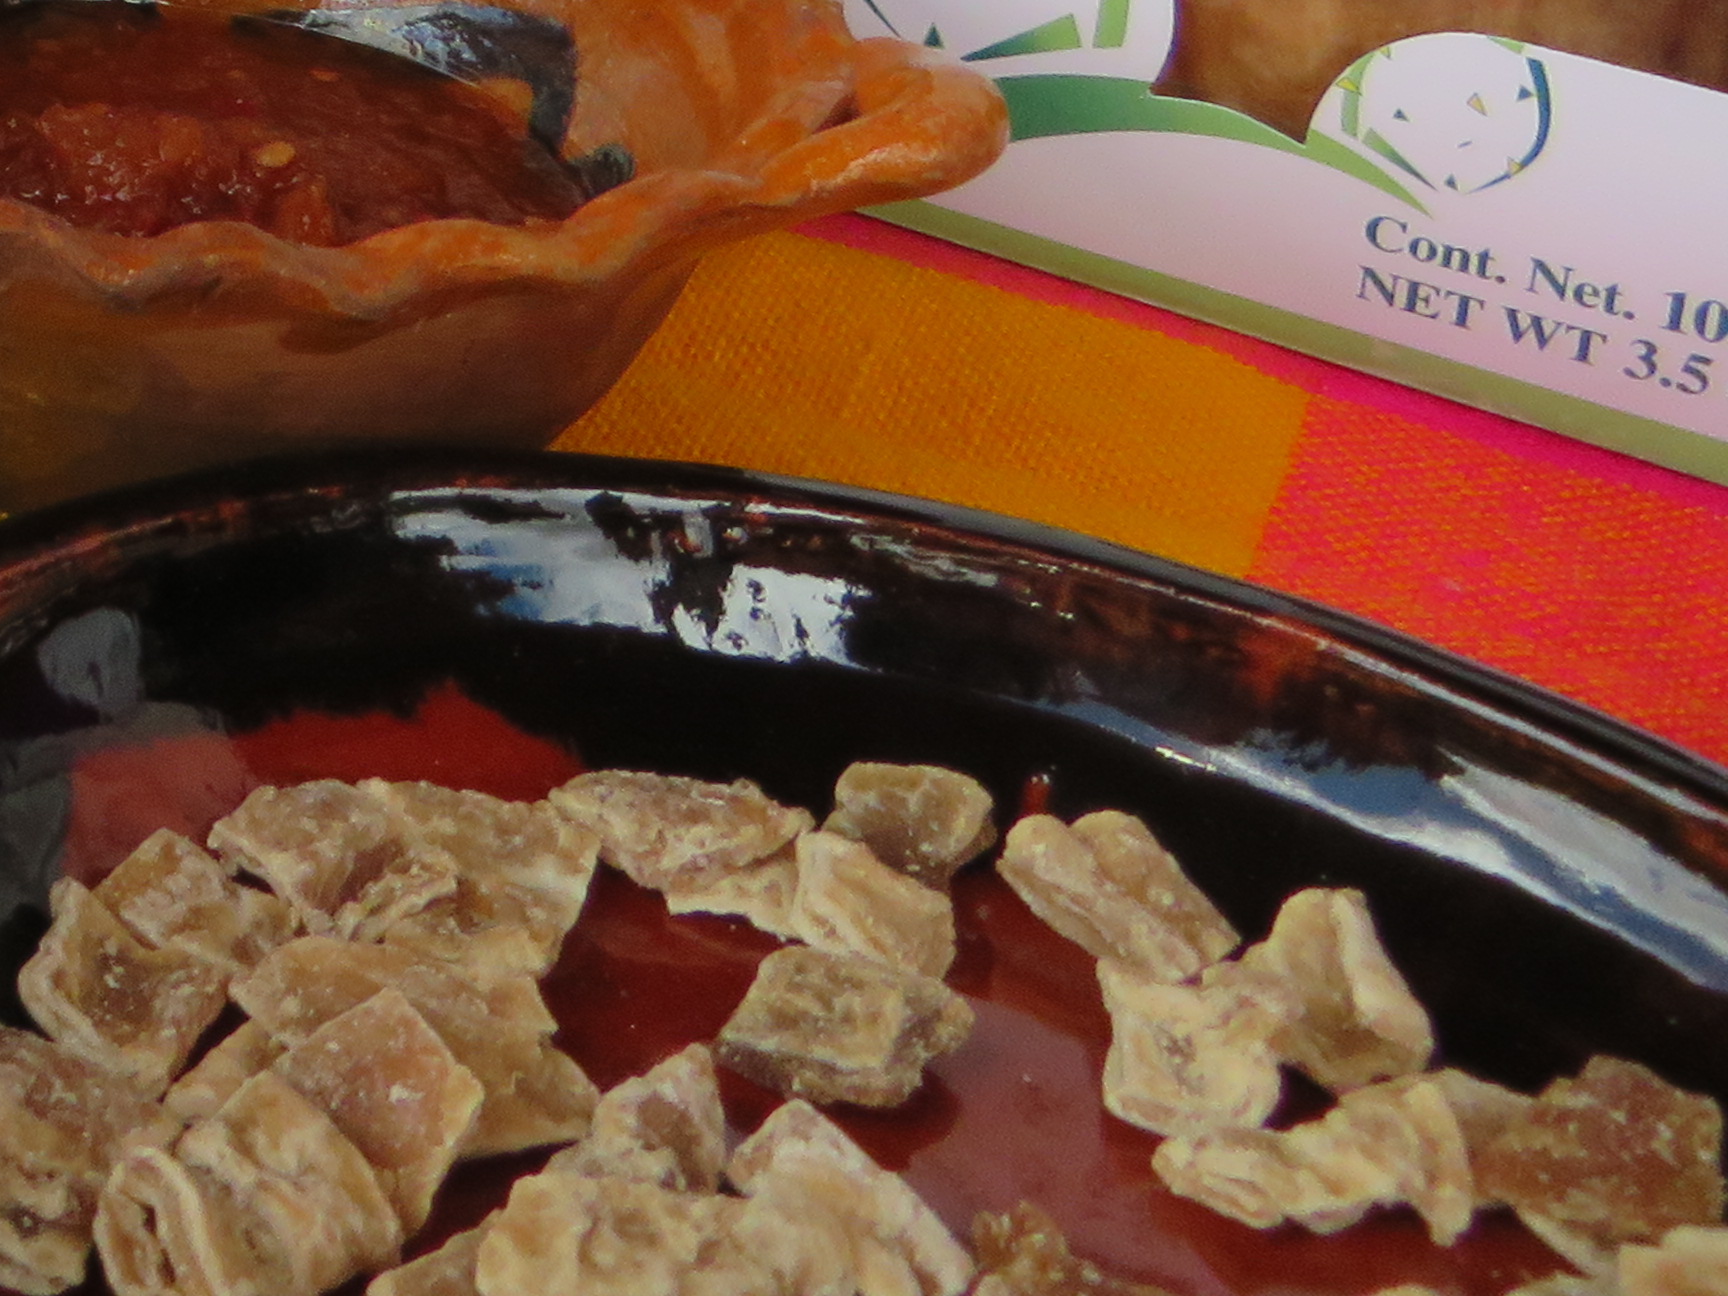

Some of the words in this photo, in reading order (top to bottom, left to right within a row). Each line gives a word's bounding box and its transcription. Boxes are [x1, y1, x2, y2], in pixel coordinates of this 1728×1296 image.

[1363, 214, 1507, 285] Cont.
[1523, 256, 1637, 321] Net.
[1355, 264, 1486, 330] NET
[1501, 304, 1608, 366] WT
[1622, 338, 1714, 396] 3.5
